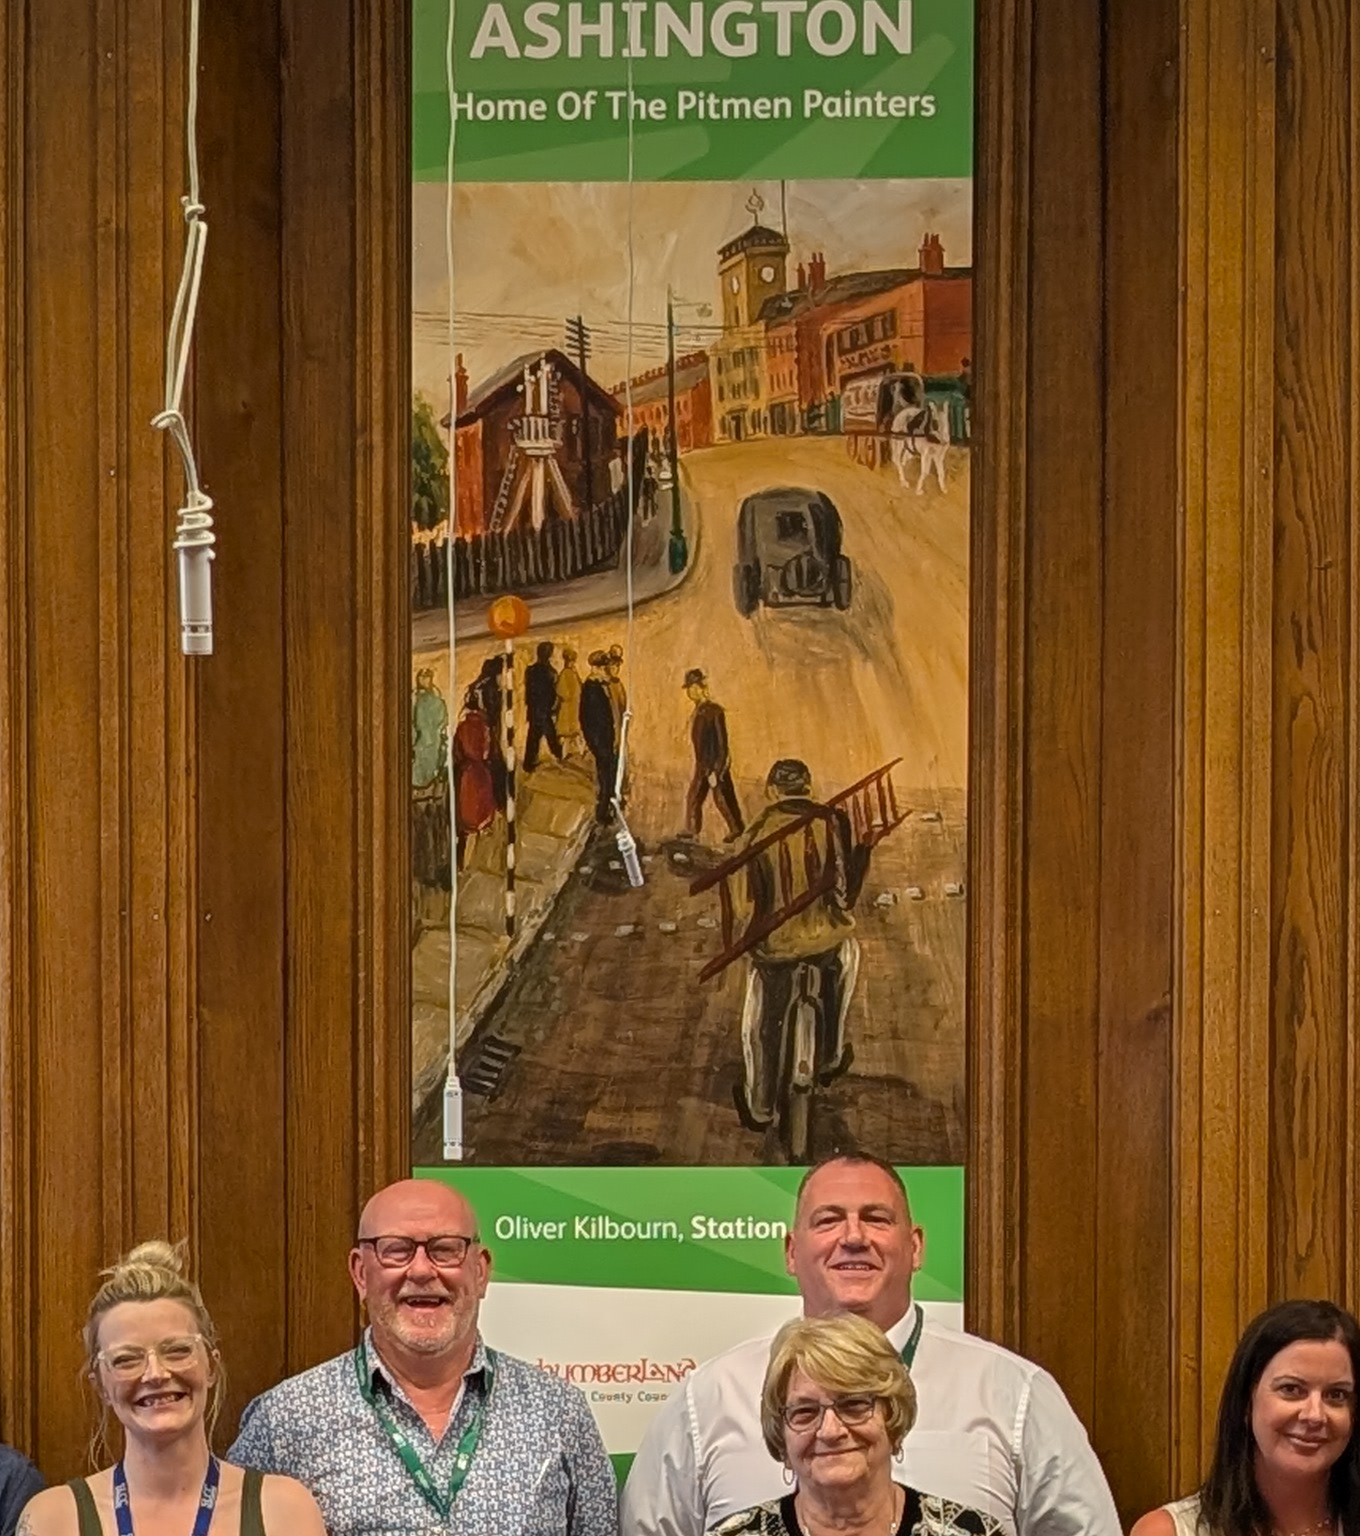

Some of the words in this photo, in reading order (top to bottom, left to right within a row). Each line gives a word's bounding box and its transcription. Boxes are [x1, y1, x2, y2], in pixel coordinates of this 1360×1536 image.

[469, 1, 913, 59] ASHINGTON
[453, 91, 547, 121] Home
[557, 90, 597, 121] Of
[606, 90, 667, 120] The
[677, 88, 793, 119] Pitmen
[803, 88, 936, 118] Painters
[495, 1215, 567, 1240] Oliver
[574, 1214, 684, 1244] Kilbourn,
[691, 1215, 787, 1240] Station
[591, 1391, 633, 1404] County
